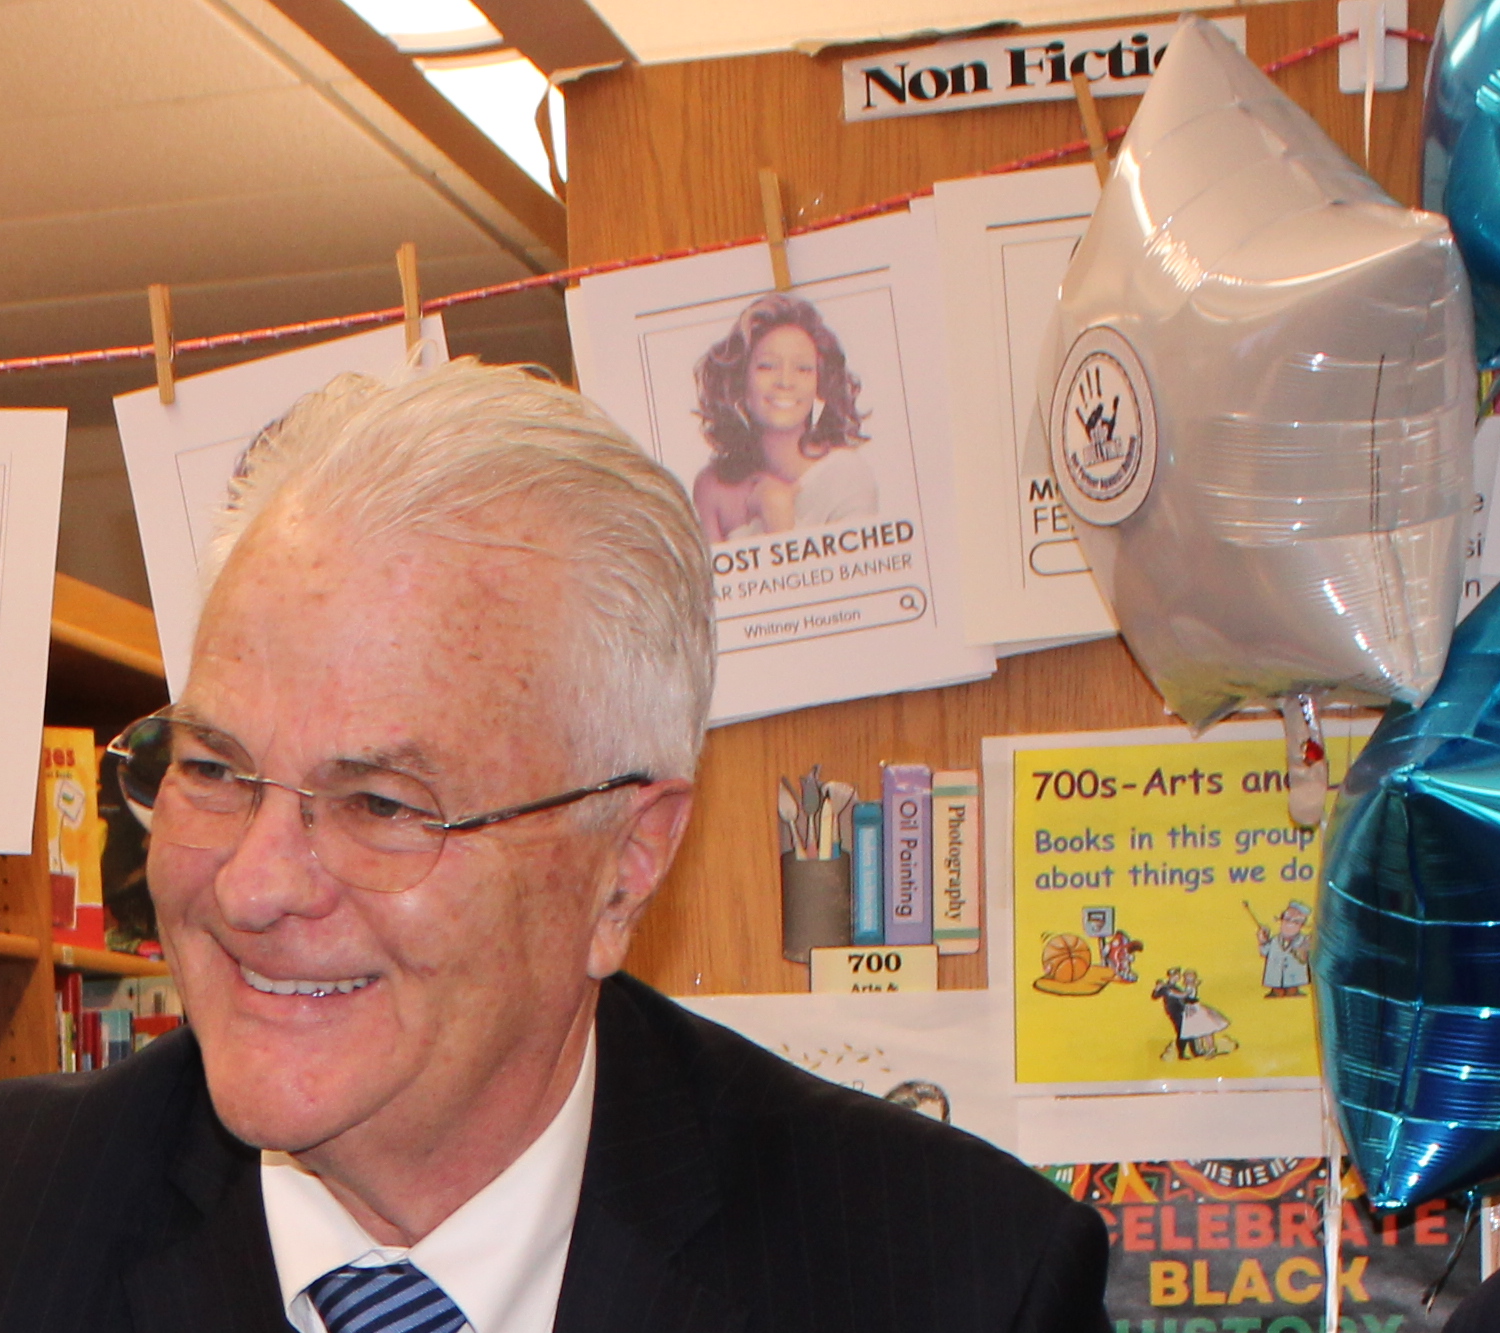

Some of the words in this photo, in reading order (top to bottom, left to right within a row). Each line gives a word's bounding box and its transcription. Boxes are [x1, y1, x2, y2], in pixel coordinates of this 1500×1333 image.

[861, 58, 993, 111] Non
[712, 546, 761, 576] OST
[771, 520, 914, 566] SEARCHED
[738, 566, 834, 598] SPANGLED
[840, 553, 912, 580] BANNER
[744, 617, 800, 639] Whitney
[804, 608, 862, 629] Houston
[900, 800, 920, 831] Oil
[1035, 827, 1116, 853] Books
[1130, 827, 1153, 850] in
[1167, 824, 1221, 849] this
[1235, 825, 1316, 854] group
[894, 839, 919, 918] Painting
[943, 803, 967, 923] Photography
[1035, 865, 1115, 891] about
[1128, 861, 1214, 894] things
[1229, 865, 1266, 883] we
[1280, 856, 1315, 882] do
[847, 951, 902, 974] 700
[1149, 1255, 1371, 1308] BLACK
